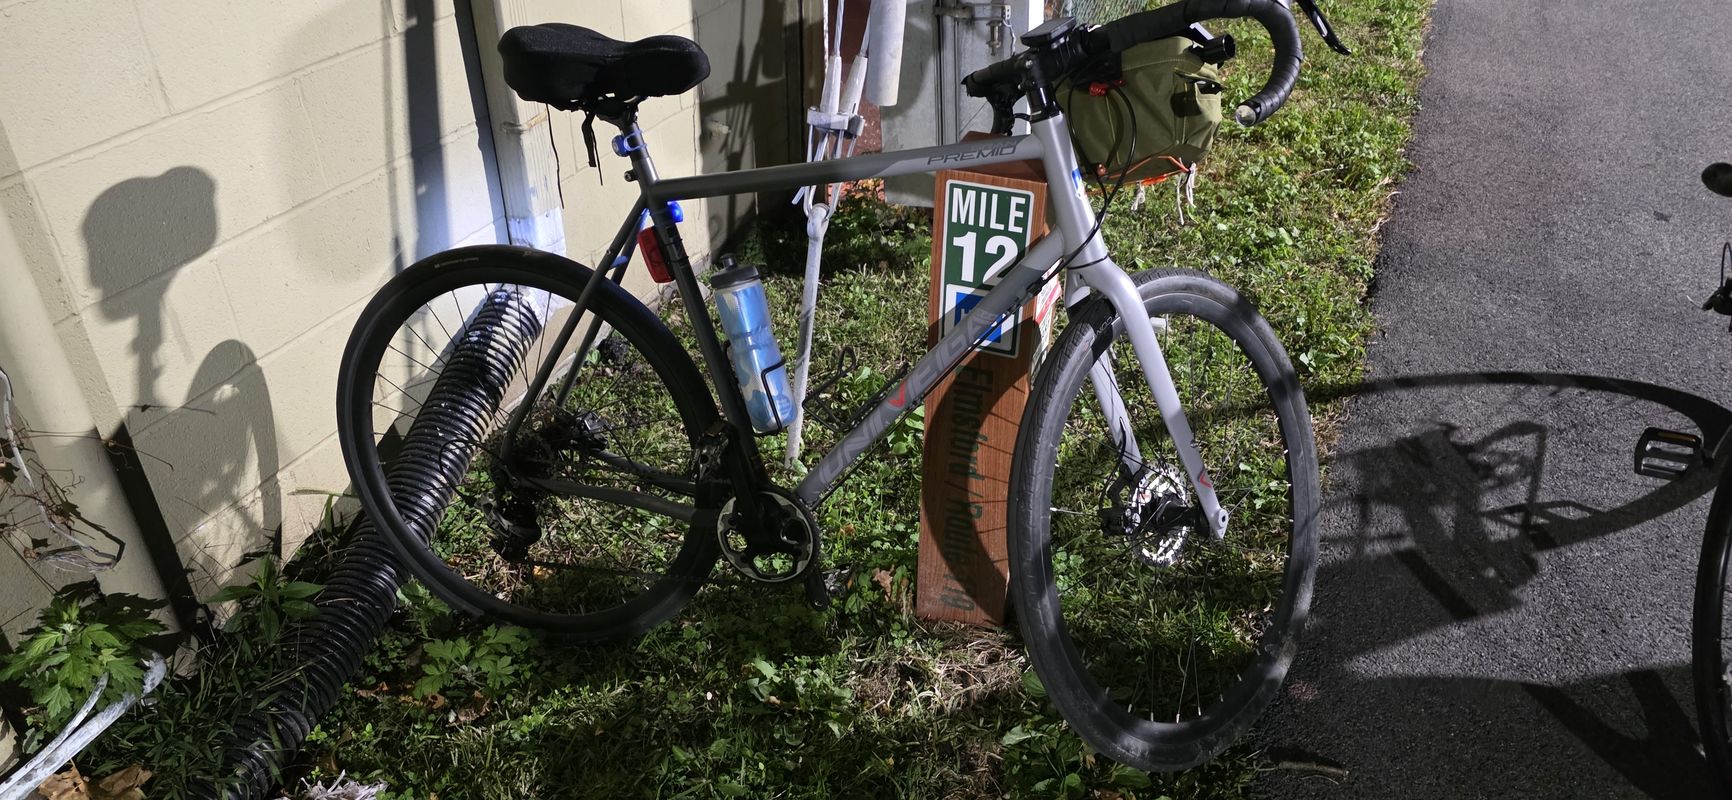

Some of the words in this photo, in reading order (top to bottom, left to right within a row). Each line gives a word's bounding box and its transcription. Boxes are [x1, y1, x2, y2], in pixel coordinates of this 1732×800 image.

[927, 145, 1018, 166] PREMIO
[951, 187, 1026, 234] MILE
[952, 231, 1019, 286] 12
[818, 306, 998, 486] UNIVEGA
[949, 365, 994, 480] Elmsford
[943, 498, 983, 566] Route
